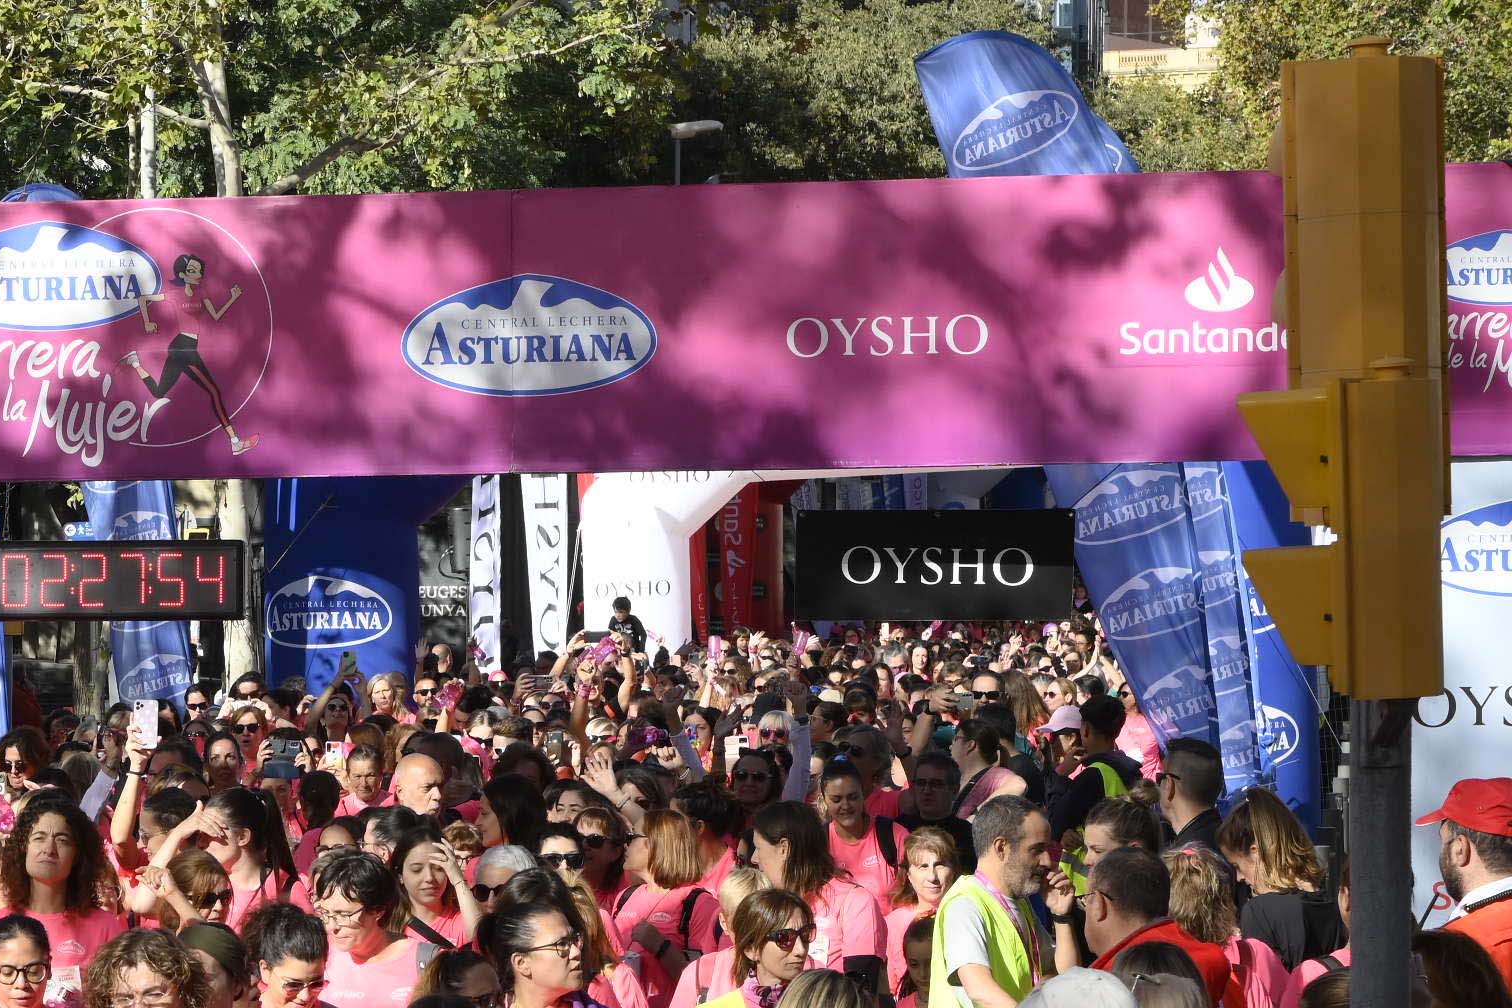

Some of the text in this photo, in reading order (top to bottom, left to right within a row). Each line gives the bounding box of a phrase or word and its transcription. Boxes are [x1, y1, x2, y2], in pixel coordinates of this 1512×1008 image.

[461, 315, 629, 330] CENTRAL LECHERA
[786, 313, 989, 359] OYSHO
[1119, 319, 1288, 354] Santand
[422, 322, 636, 367] ASTURIANA
[1470, 340, 1488, 369] la
[2, 381, 28, 422] la
[22, 374, 171, 468] Mujer
[1, 552, 225, 608] 02:27:54
[841, 545, 1034, 587] OYSHO
[329, 600, 379, 608] LECHERA
[595, 579, 671, 598] OYSHO
[270, 606, 383, 632] ASTURIANA
